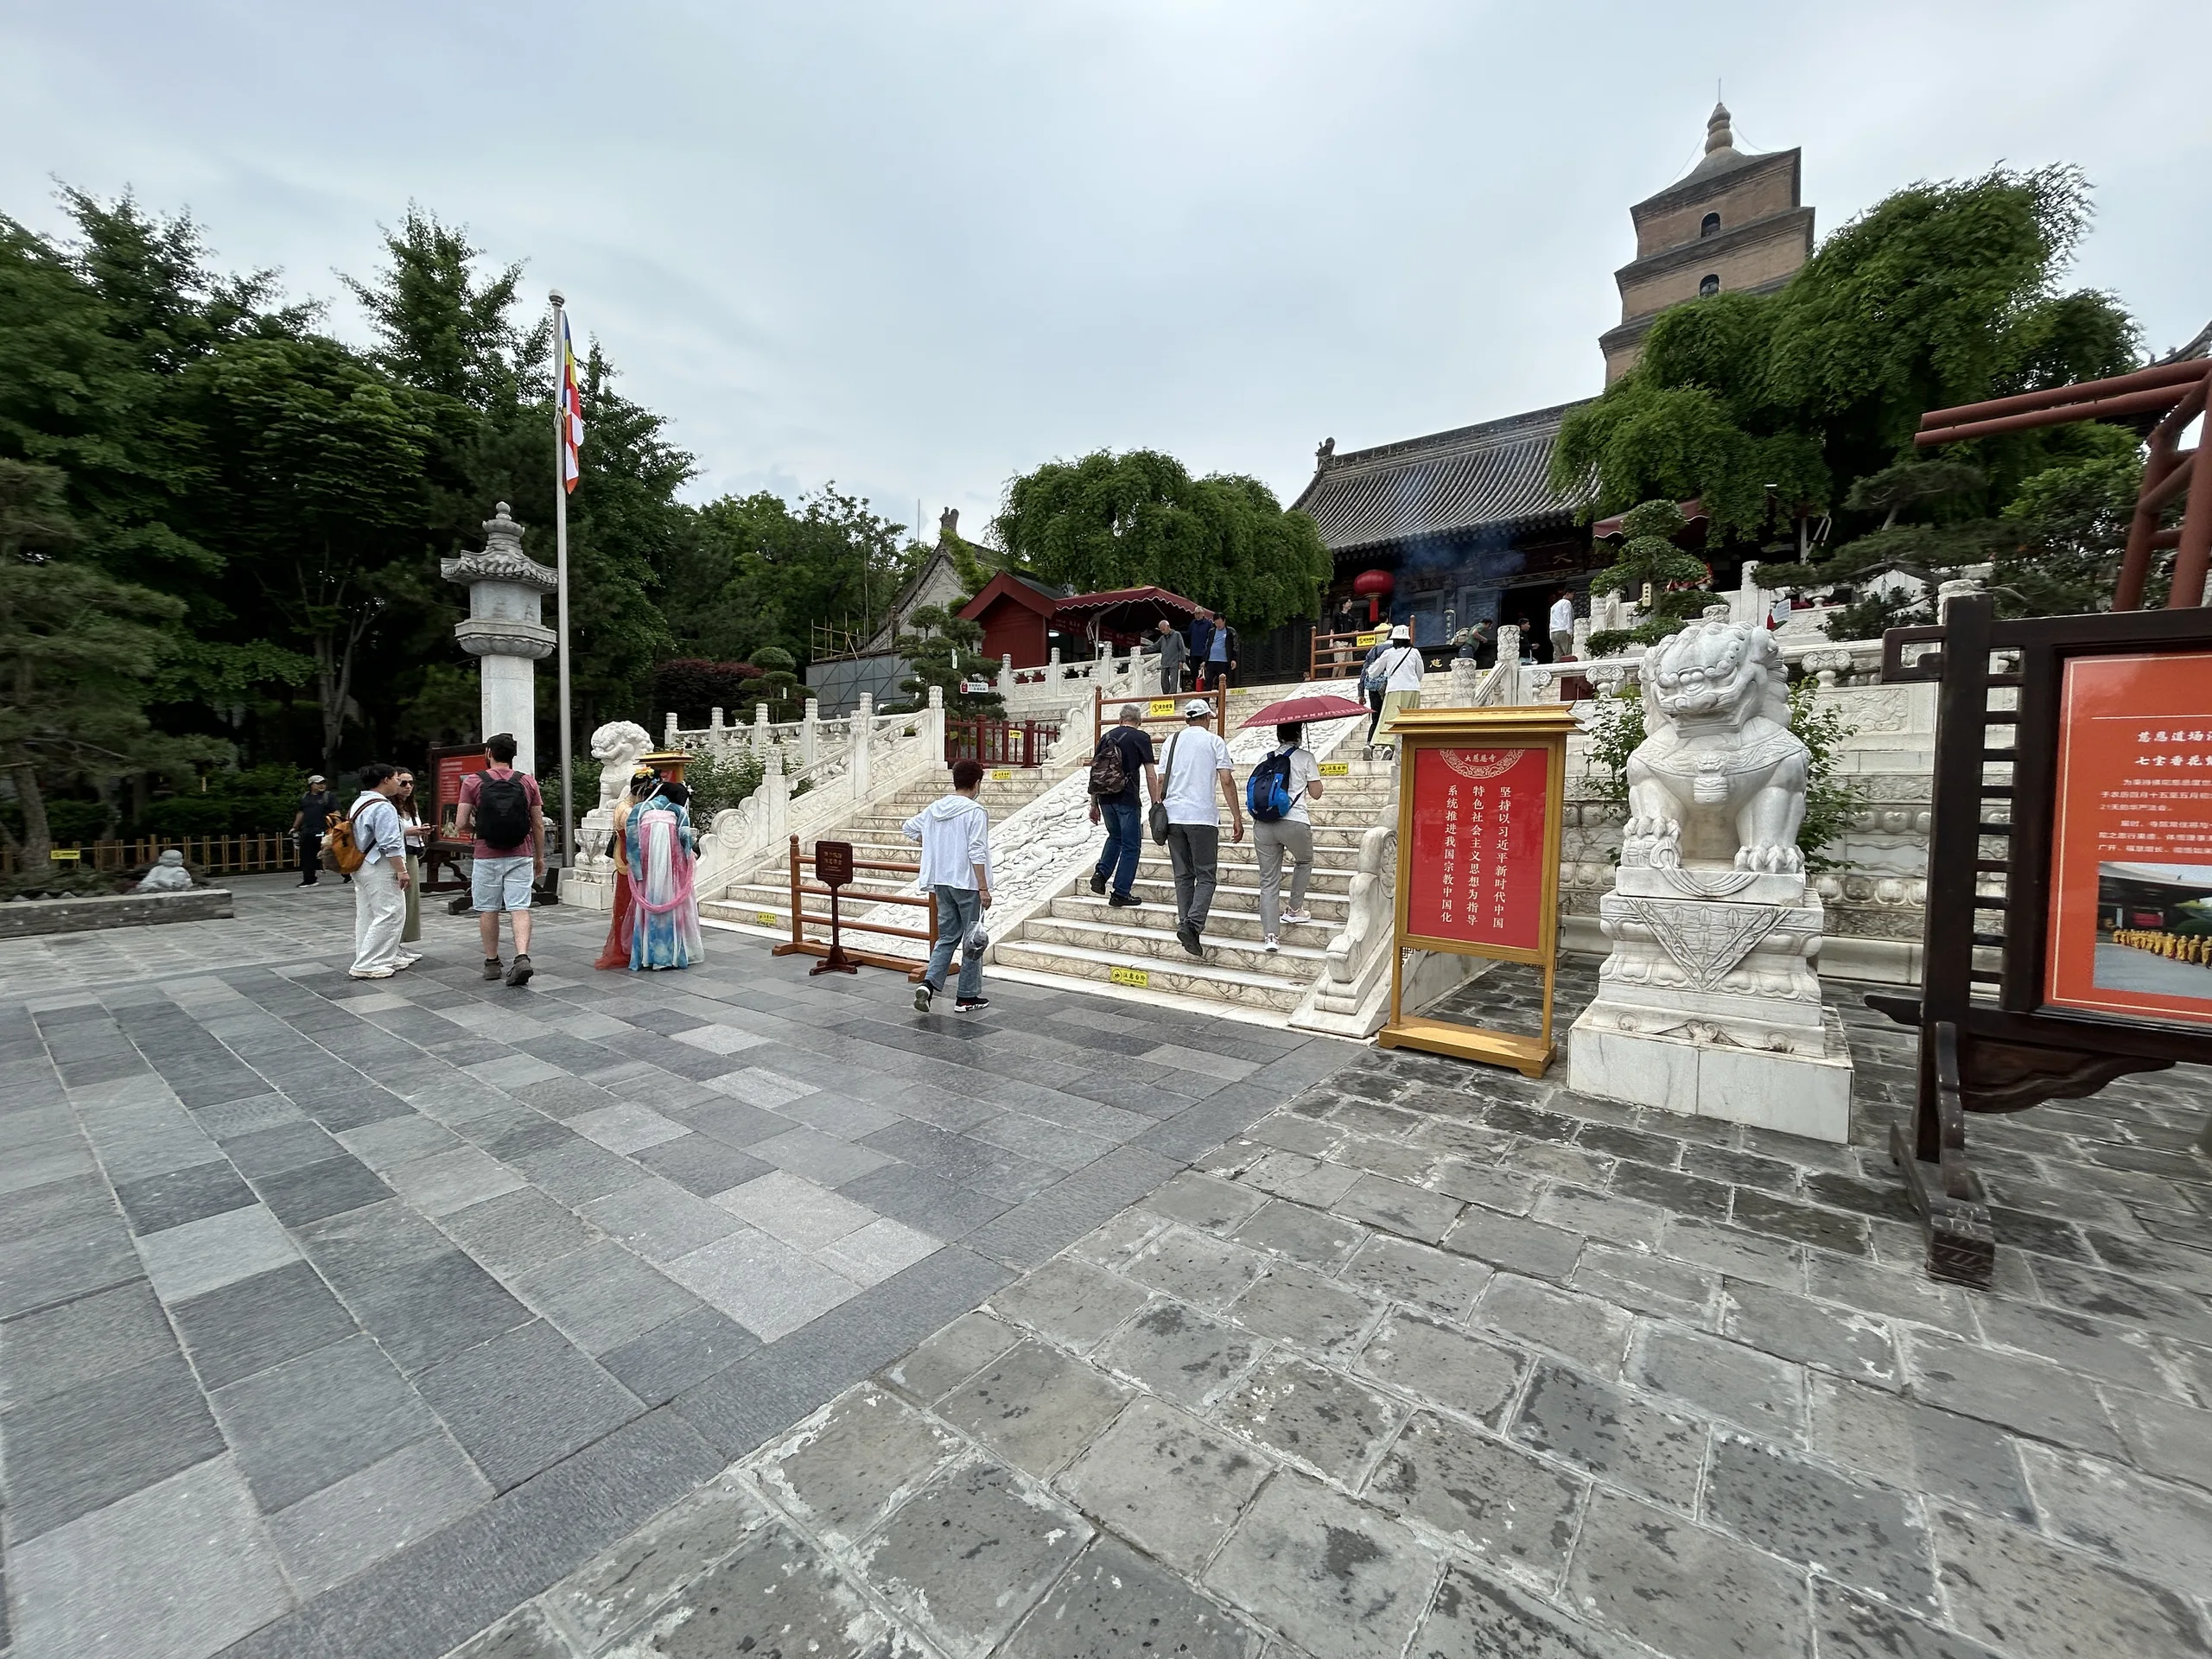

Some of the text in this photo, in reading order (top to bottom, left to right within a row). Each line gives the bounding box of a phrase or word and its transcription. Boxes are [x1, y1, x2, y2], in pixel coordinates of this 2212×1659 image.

[1440, 785, 1459, 923] 系统推进我国宗教中国化
[1466, 785, 1485, 926] 特色社会主义思想为指导
[1492, 786, 1512, 929] 坚持以习近平新时代中国
[1123, 972, 1146, 982] 注意台阶
